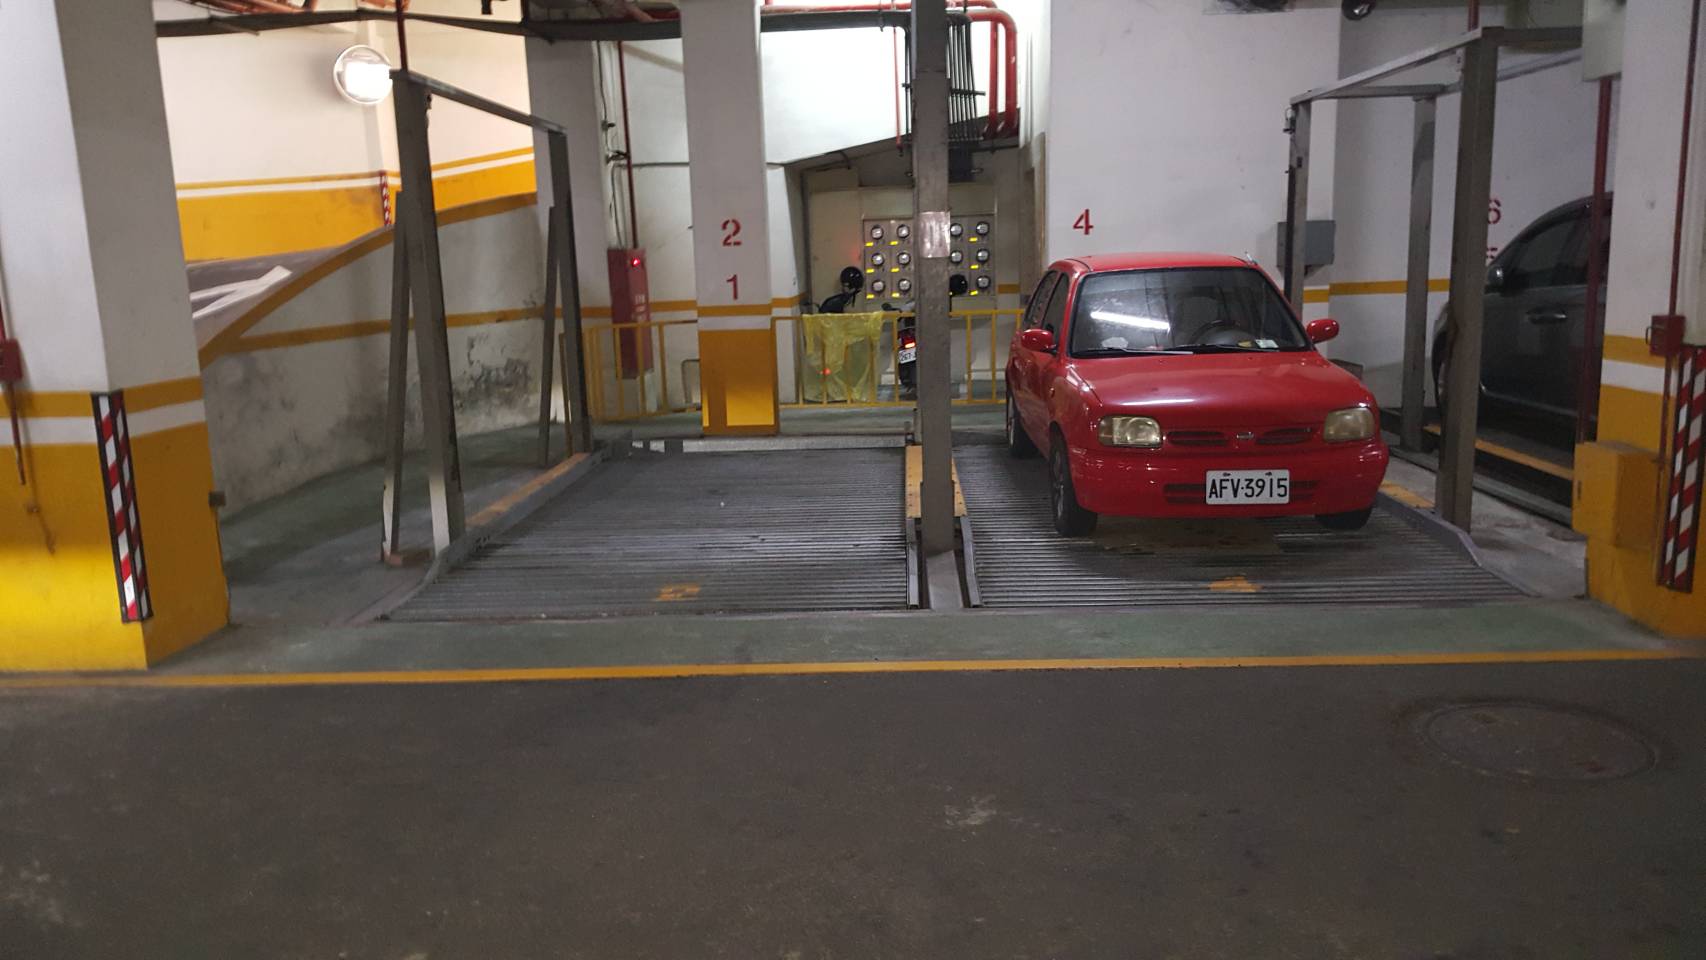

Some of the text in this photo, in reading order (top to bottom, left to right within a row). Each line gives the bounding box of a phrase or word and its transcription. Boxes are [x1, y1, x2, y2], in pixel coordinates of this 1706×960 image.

[721, 219, 742, 247] 2
[1073, 209, 1094, 235] 4
[726, 274, 738, 301] 1
